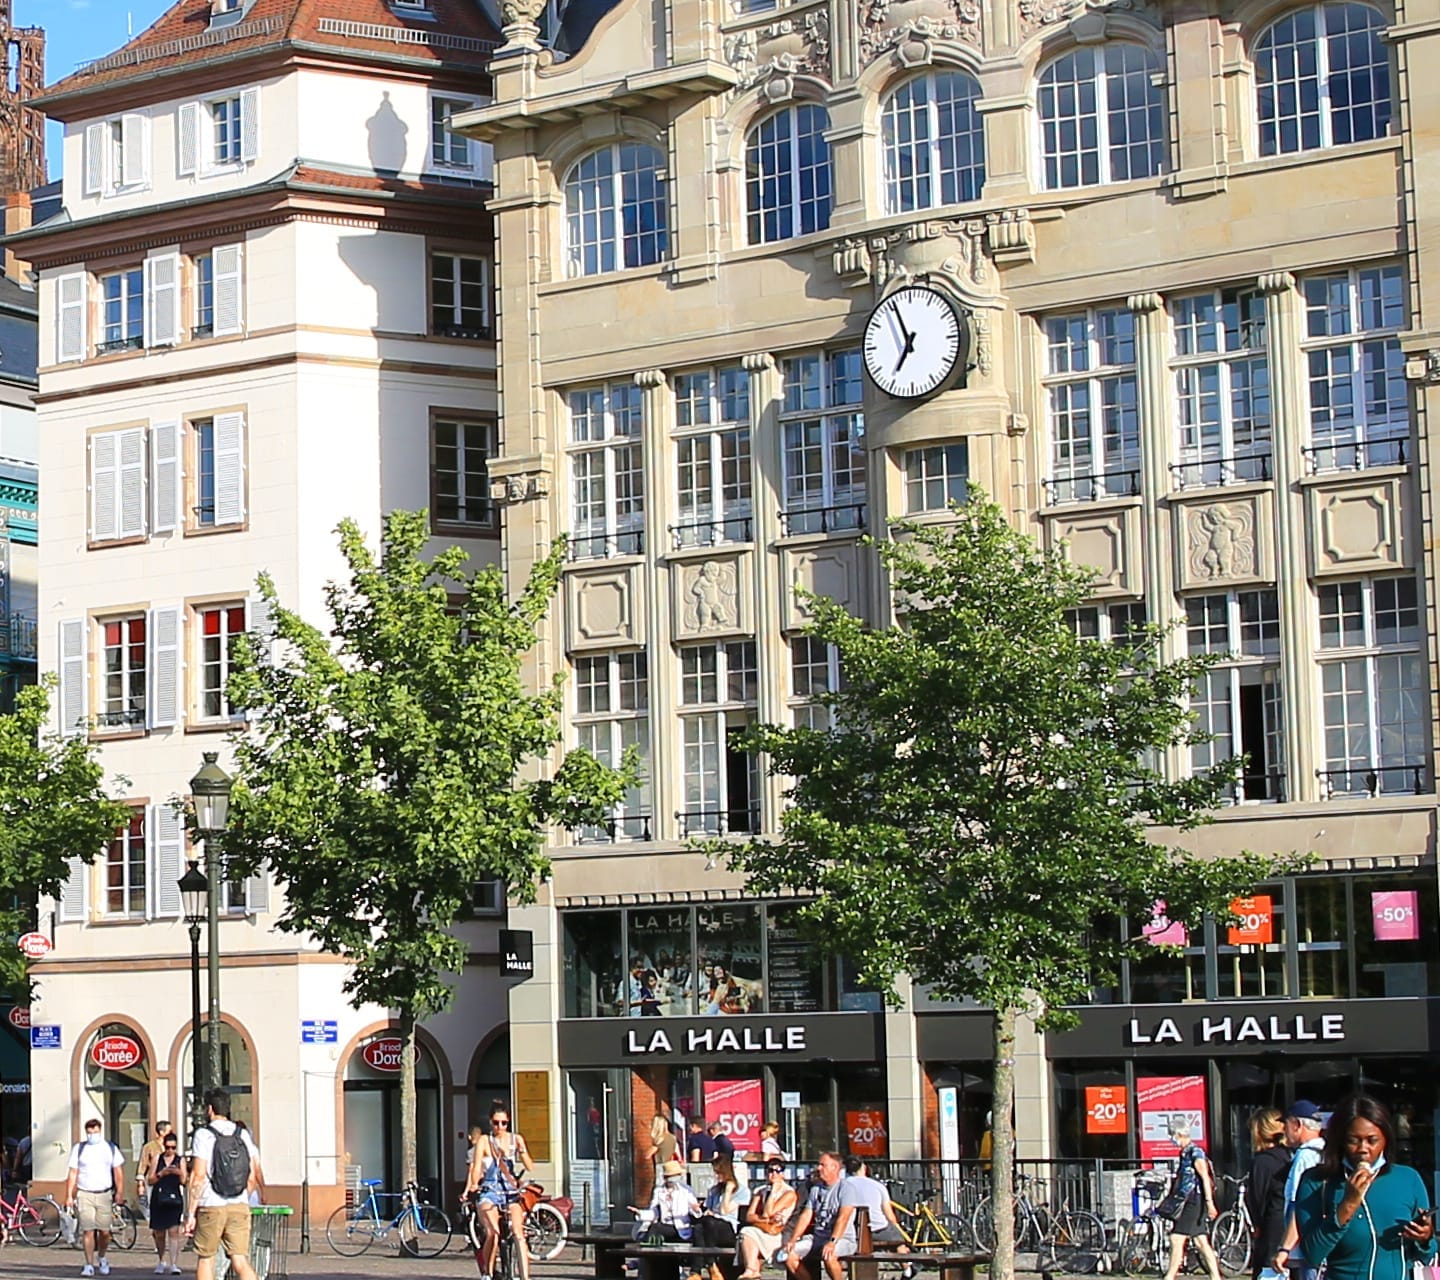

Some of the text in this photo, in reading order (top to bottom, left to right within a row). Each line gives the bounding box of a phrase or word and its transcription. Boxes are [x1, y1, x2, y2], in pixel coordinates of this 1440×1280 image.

[1240, 913, 1269, 930] 20%
[1377, 907, 1413, 922] -50%
[507, 953, 517, 961] LA
[507, 961, 532, 970] HALLE
[14, 1013, 30, 1024] Dor
[1131, 1015, 1345, 1043] LA HALLE
[628, 1026, 807, 1053] LA HALLE
[99, 1048, 133, 1064] Dorée
[1087, 1103, 1126, 1120] -20%
